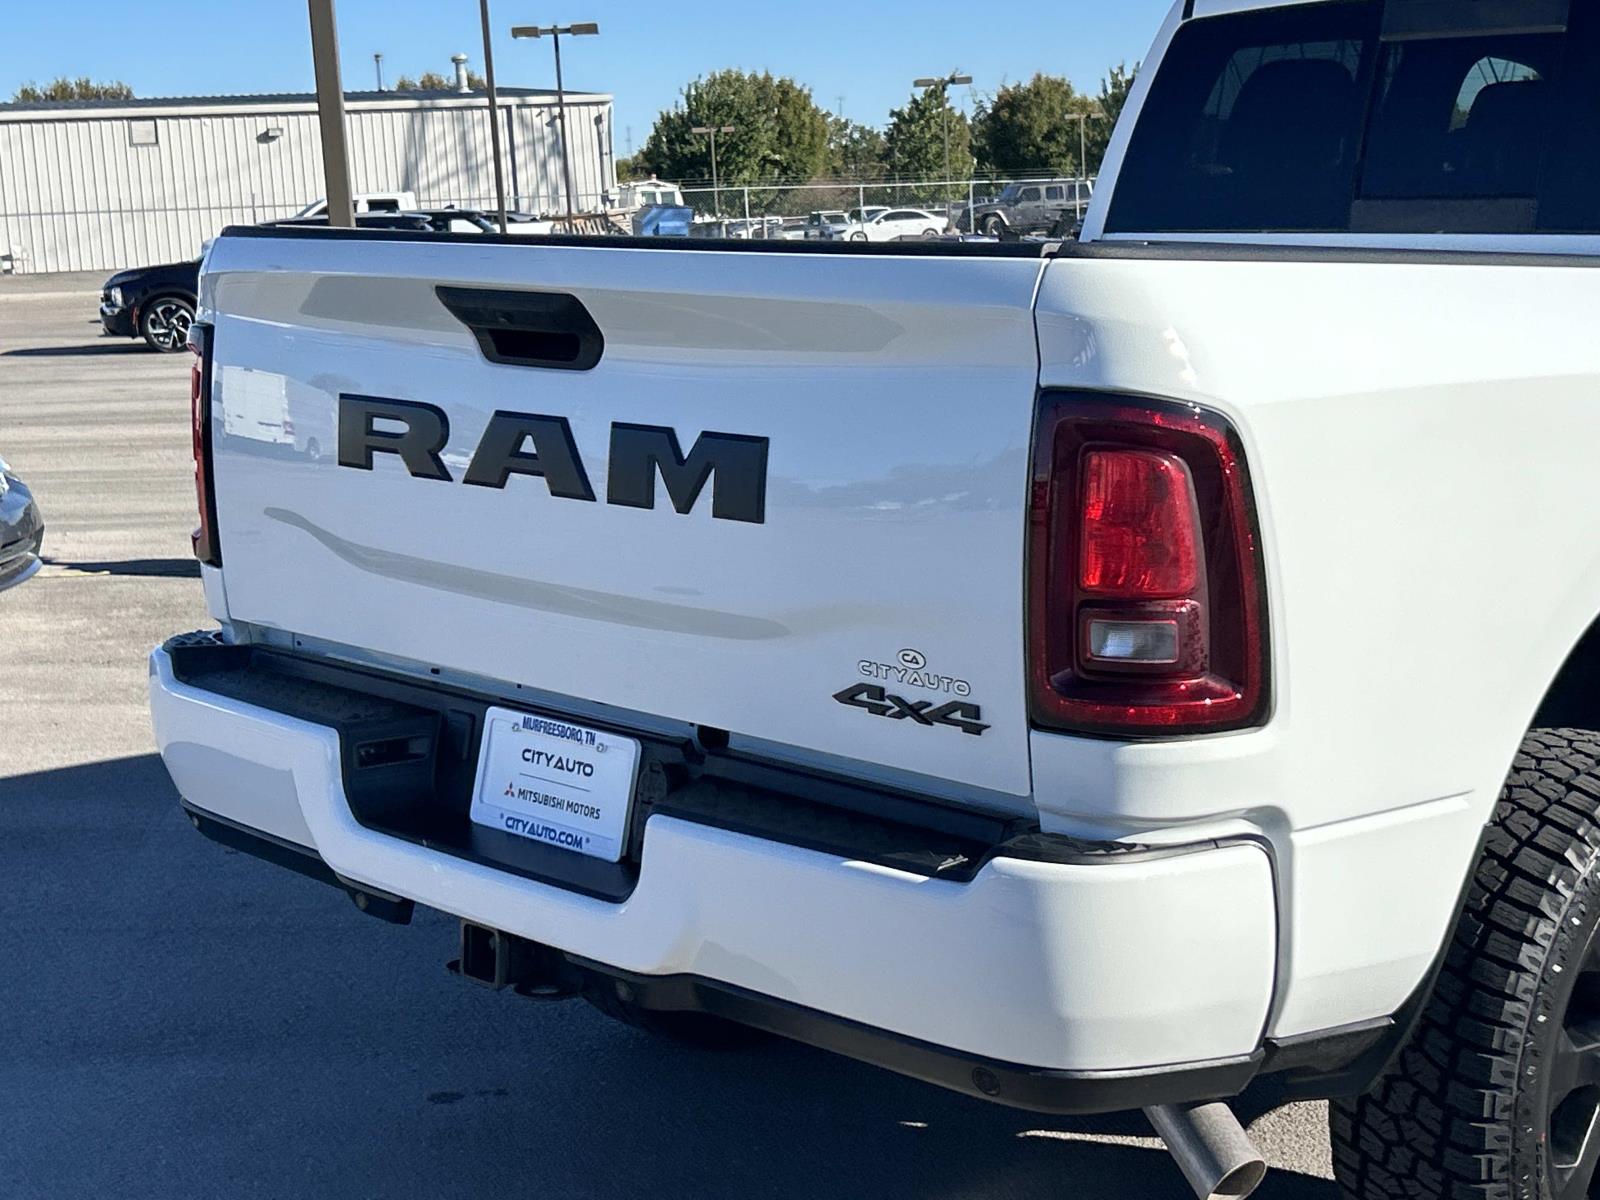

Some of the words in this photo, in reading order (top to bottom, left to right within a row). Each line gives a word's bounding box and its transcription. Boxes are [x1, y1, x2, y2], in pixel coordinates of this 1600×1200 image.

[338, 393, 770, 524] RAM
[522, 716, 584, 745] MURFREESBORO,
[585, 732, 596, 746] TN
[517, 788, 565, 810] MITSUBISHI
[566, 799, 601, 820] MOTORS
[505, 816, 583, 849] CITYAUTO.COM
